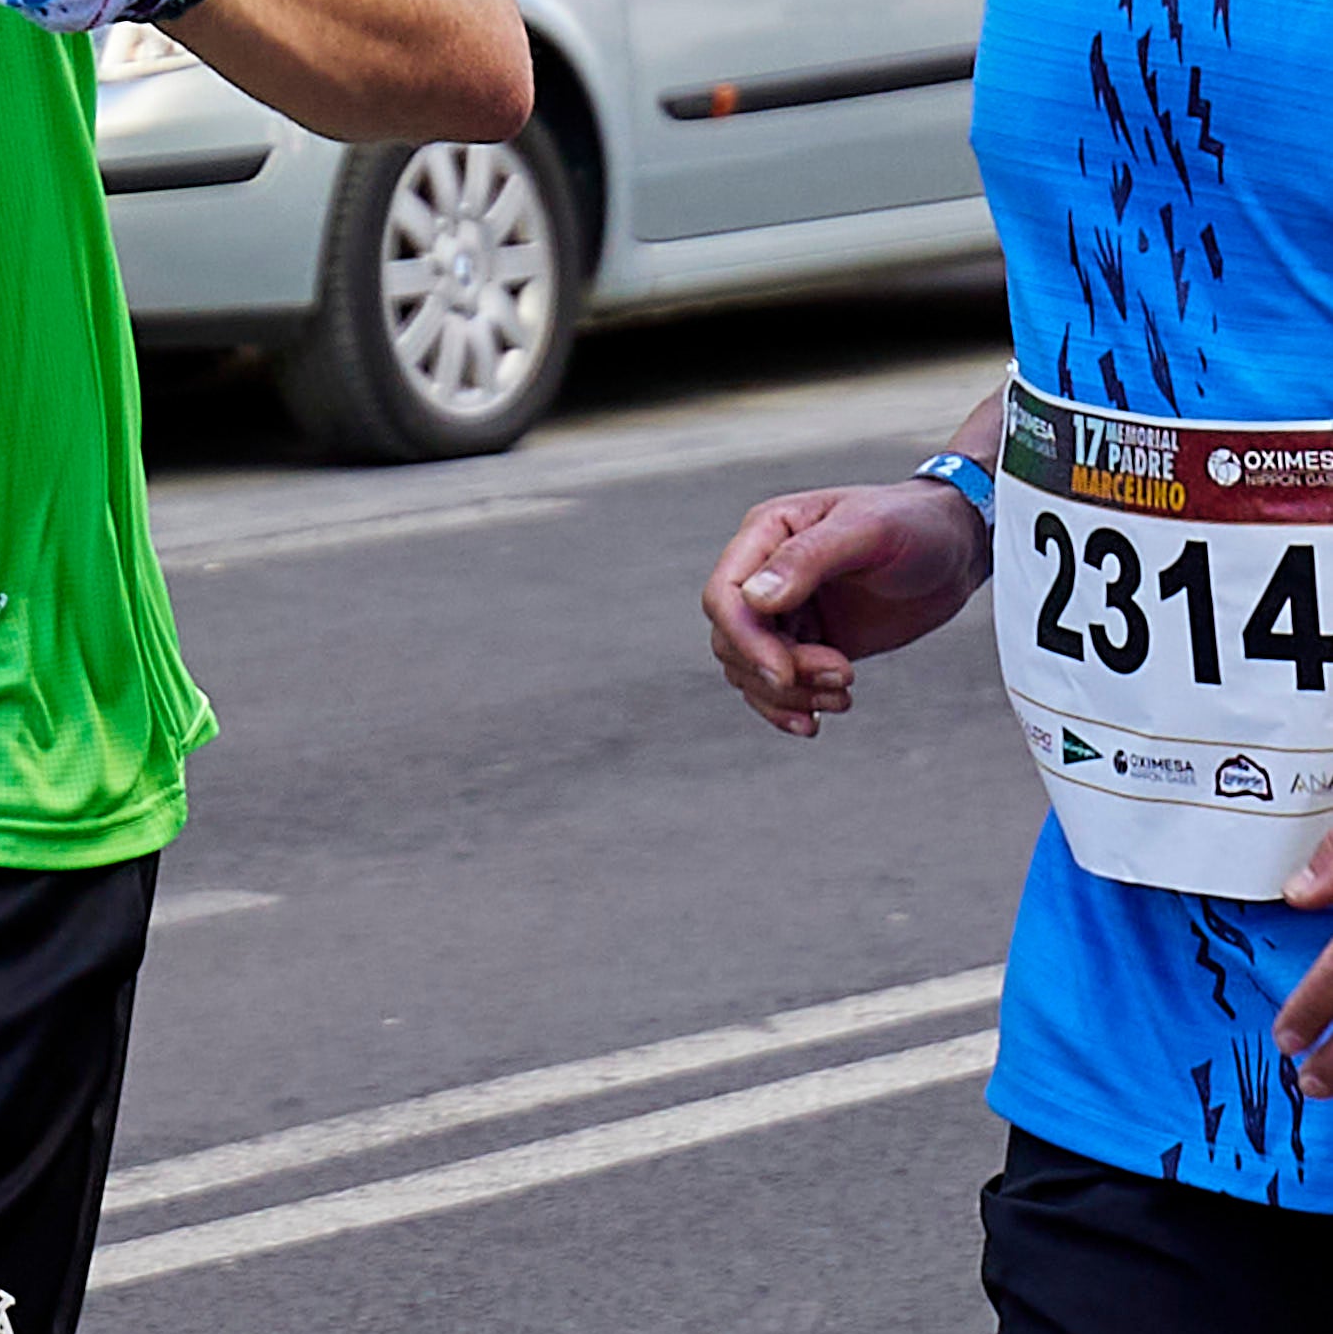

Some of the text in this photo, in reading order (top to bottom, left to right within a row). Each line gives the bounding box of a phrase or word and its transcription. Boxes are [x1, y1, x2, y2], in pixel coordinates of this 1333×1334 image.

[1073, 413, 1107, 467] 17
[1106, 421, 1179, 452] MEMORIAL
[1108, 443, 1174, 482] PADRE
[1071, 464, 1187, 512] MARCELINO
[1033, 510, 1333, 692] 2314
[1130, 753, 1195, 773] OXIMESA
